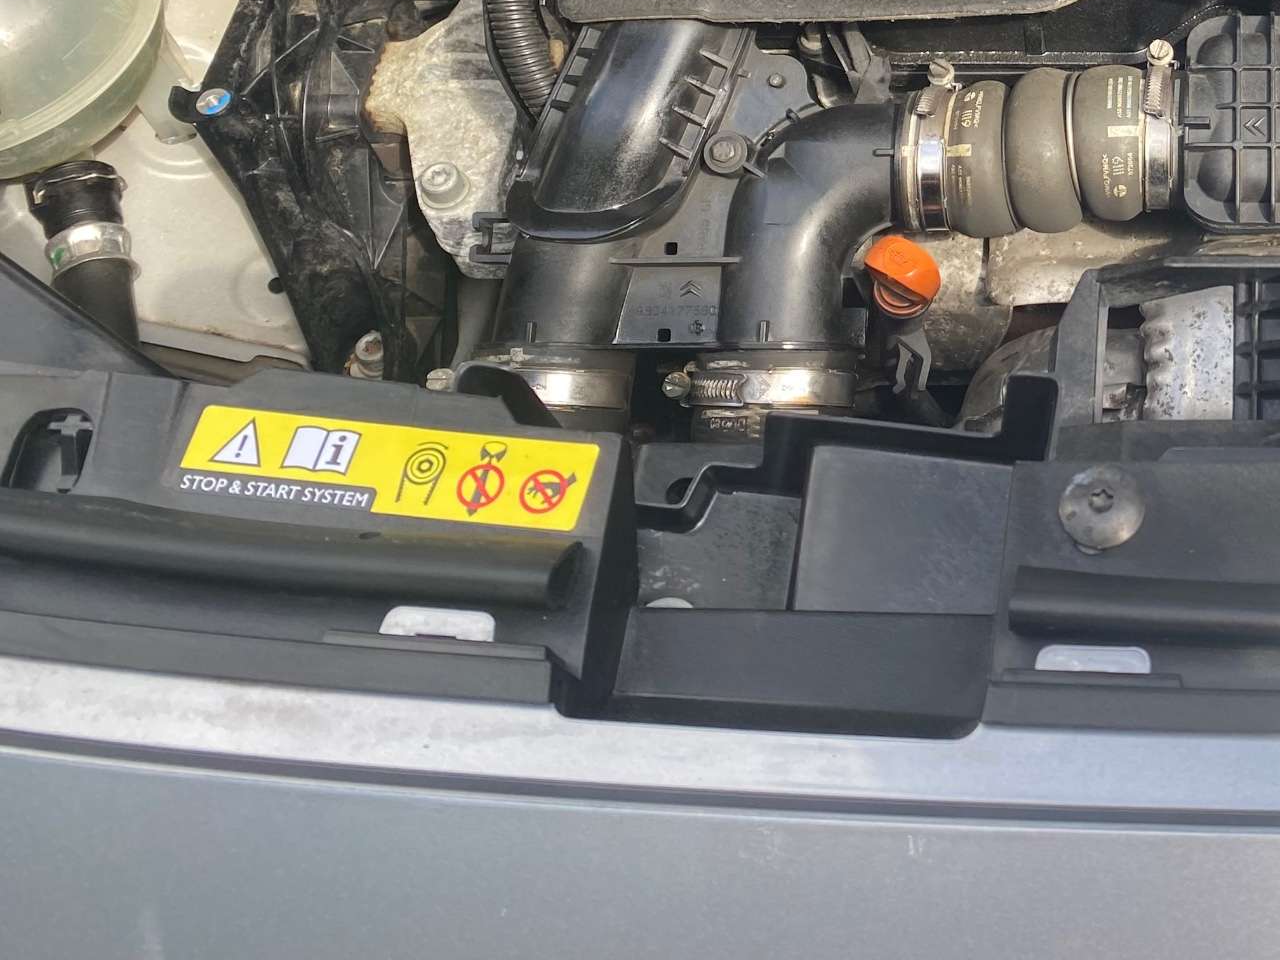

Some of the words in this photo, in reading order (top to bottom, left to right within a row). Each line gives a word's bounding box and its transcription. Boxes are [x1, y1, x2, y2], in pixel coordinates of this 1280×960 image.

[180, 474, 229, 493] STOP
[228, 480, 242, 495] &
[245, 482, 301, 502] START
[301, 487, 369, 508] SYSTEM
